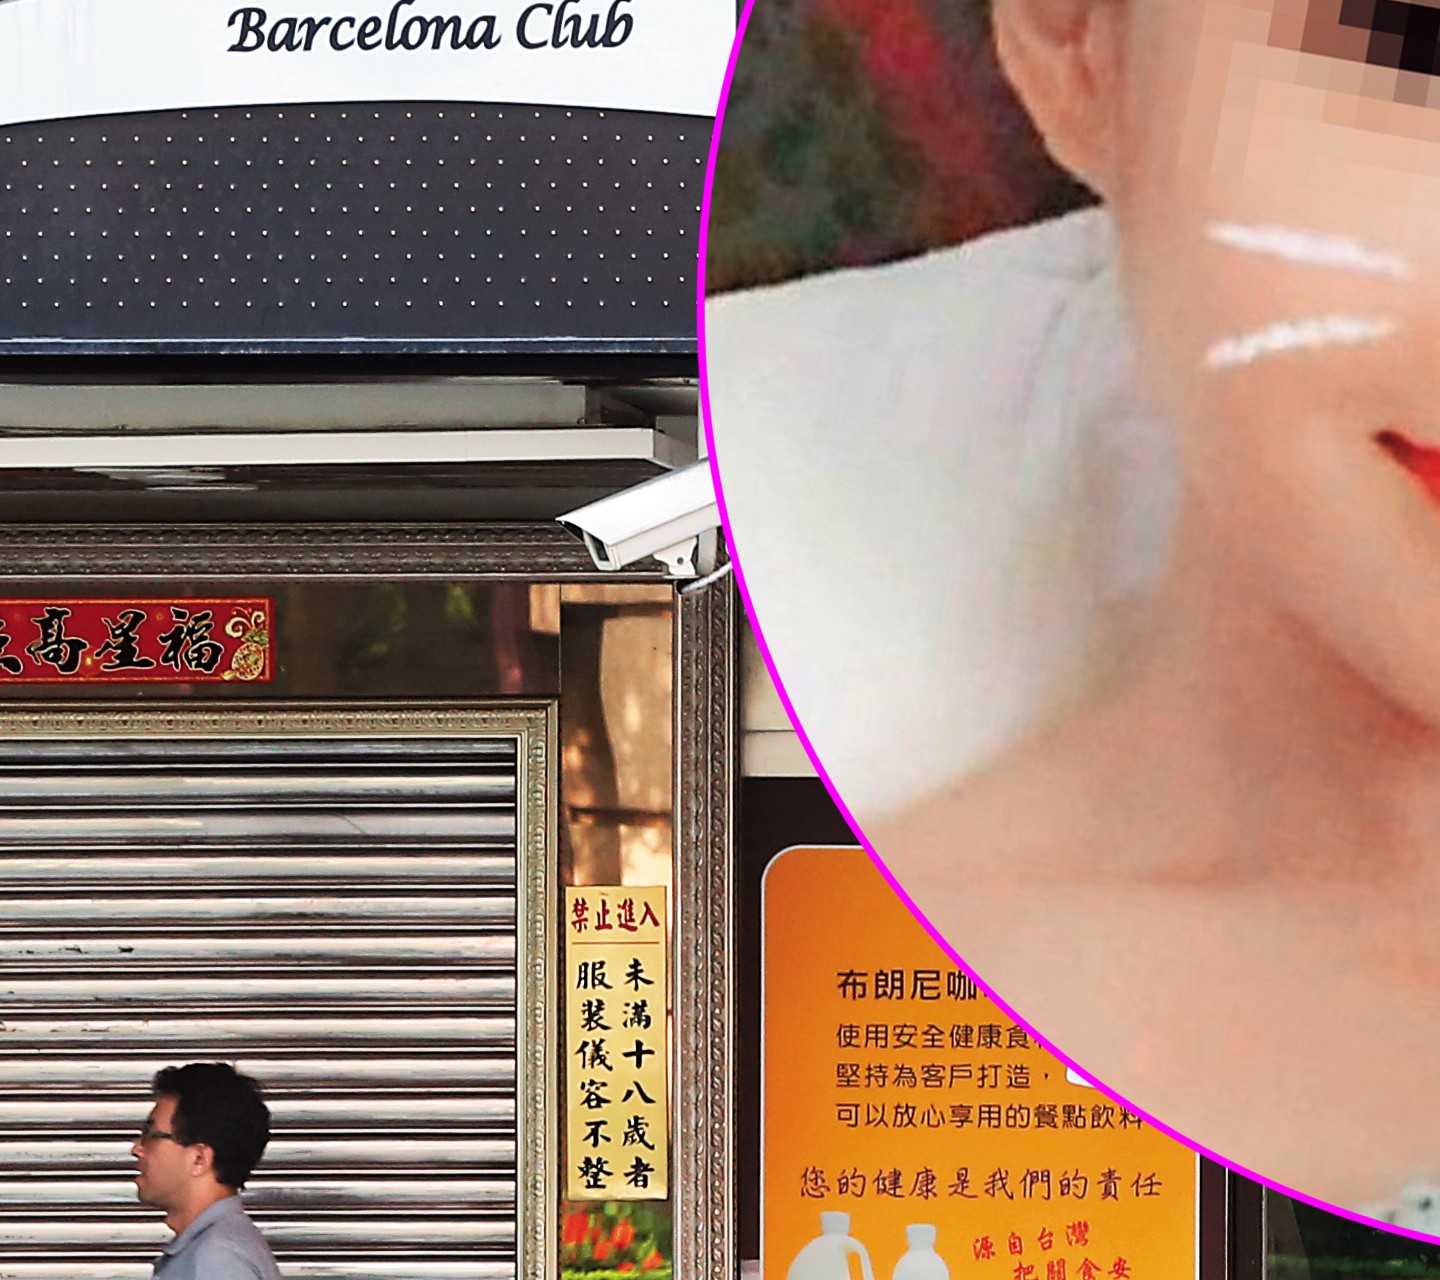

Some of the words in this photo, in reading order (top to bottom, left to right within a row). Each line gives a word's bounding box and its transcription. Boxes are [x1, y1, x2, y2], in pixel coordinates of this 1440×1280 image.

[571, 898, 660, 933] 禁止進入
[836, 969, 989, 1001] 布朗尼咖
[836, 1023, 1045, 1050] 使用安全健康食
[575, 960, 614, 1190] 服裝儀容不整
[621, 957, 657, 1190] 未滿十八歲者
[799, 1166, 1163, 1202] 您的健康是我們的責任
[972, 1220, 1091, 1261] 源自台灣
